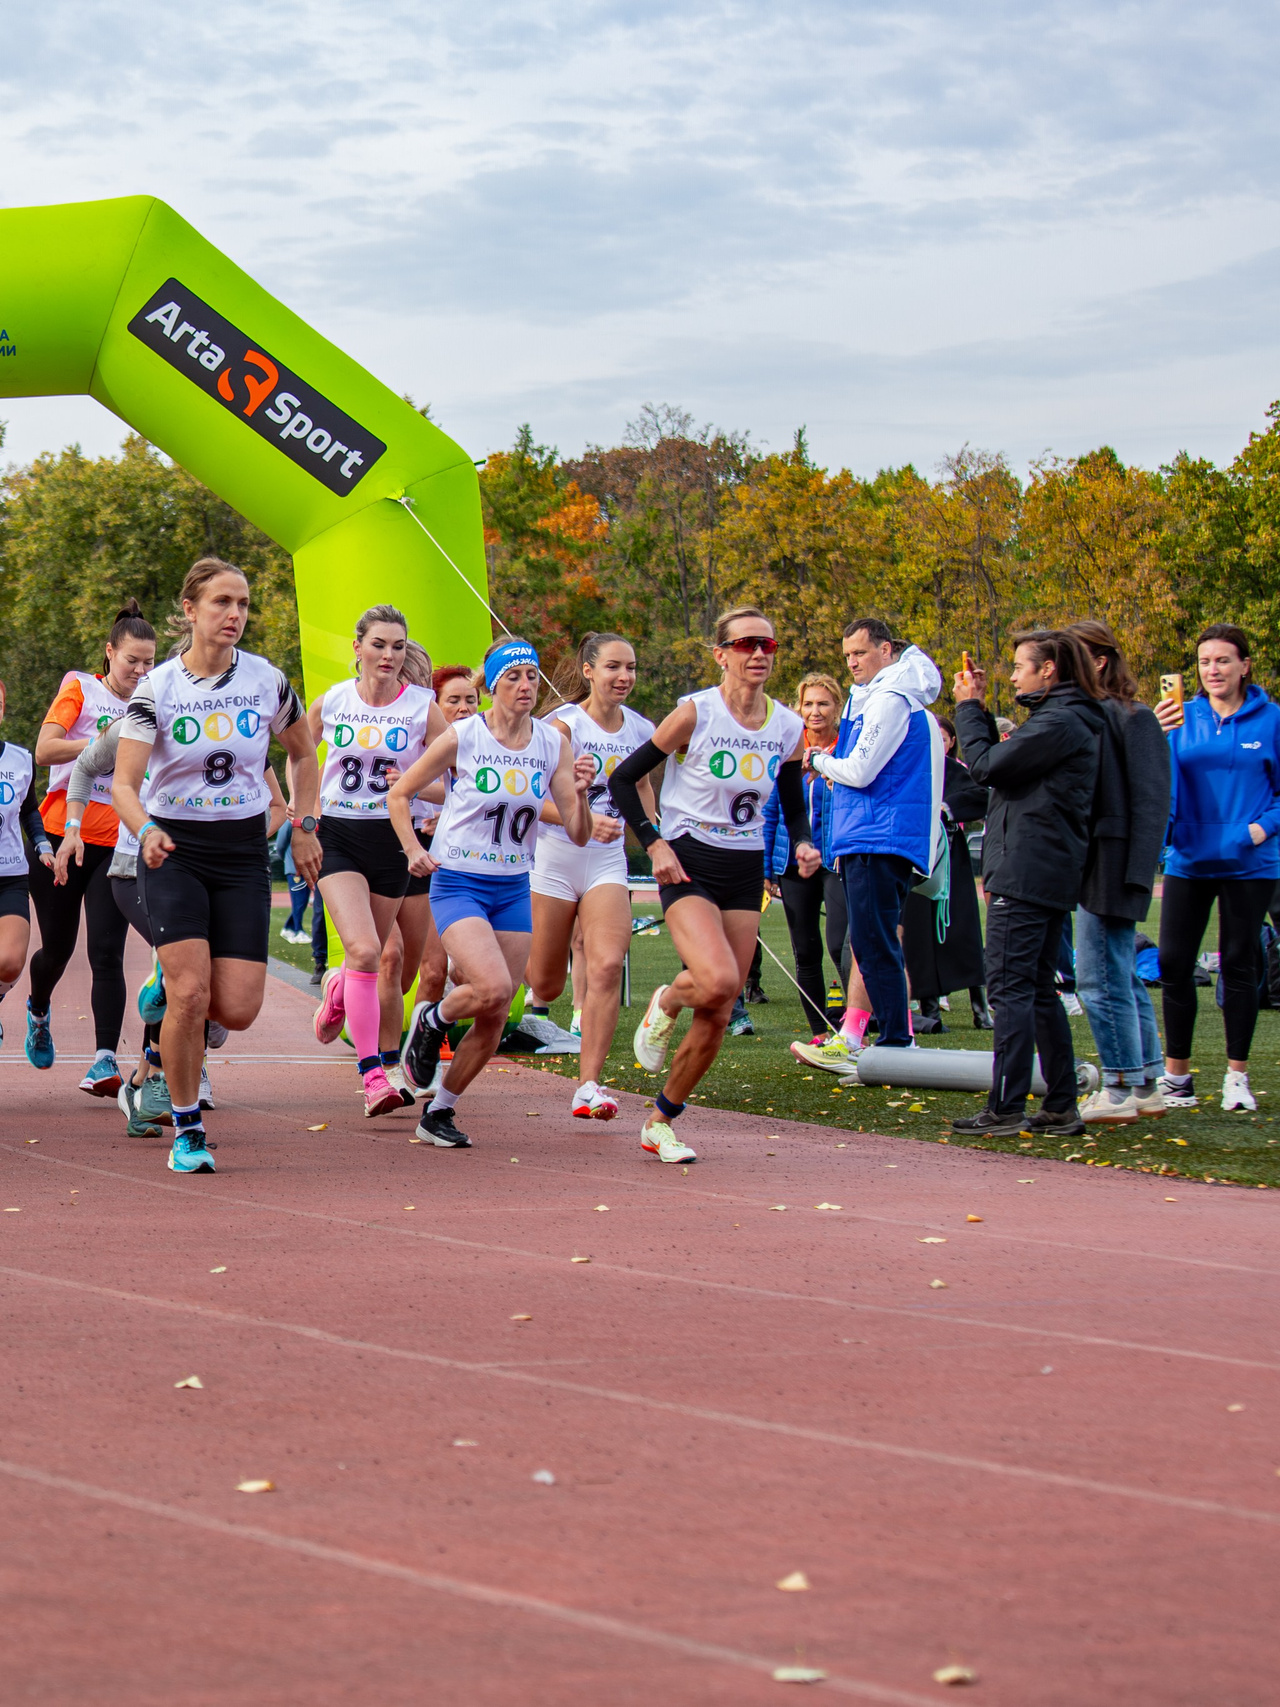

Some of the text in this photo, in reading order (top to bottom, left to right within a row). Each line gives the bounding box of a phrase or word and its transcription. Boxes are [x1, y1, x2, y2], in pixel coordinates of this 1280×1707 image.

[144, 301, 364, 479] Arta Sport
[202, 749, 237, 789] 8
[339, 755, 397, 795] 85
[483, 802, 537, 846] 10
[729, 789, 761, 828] 6
